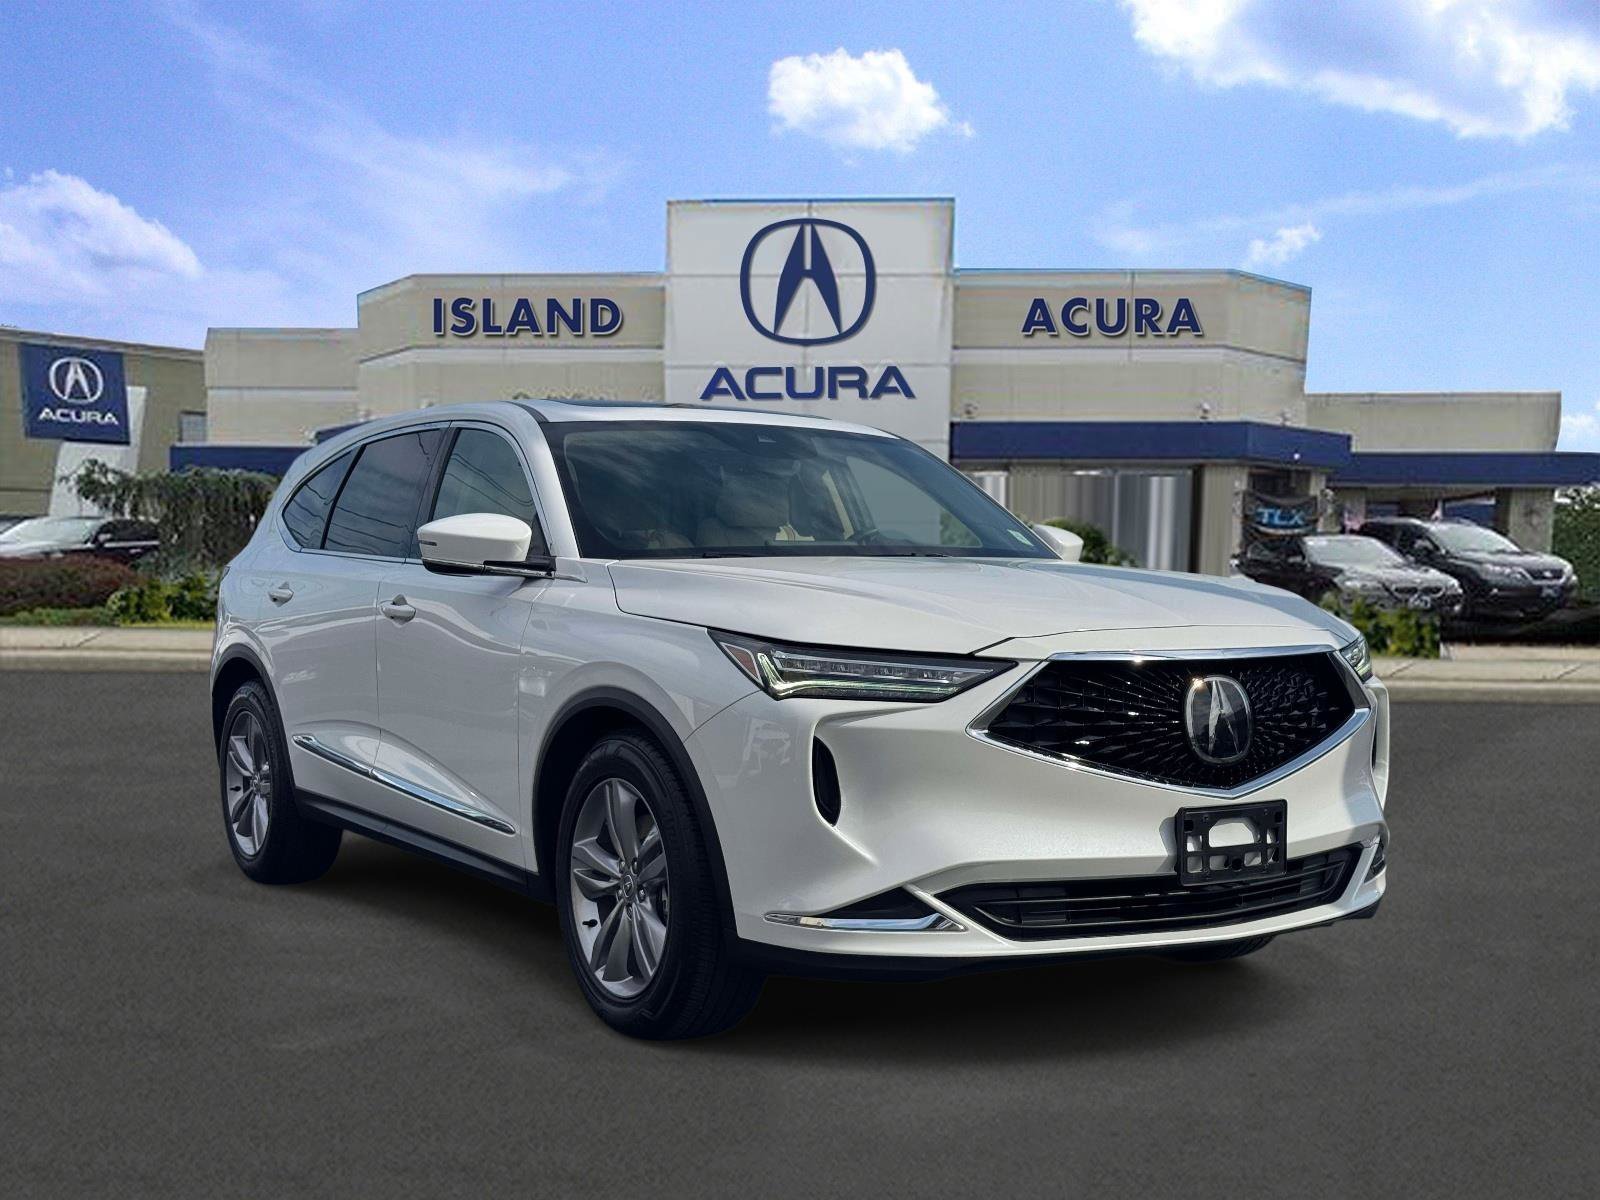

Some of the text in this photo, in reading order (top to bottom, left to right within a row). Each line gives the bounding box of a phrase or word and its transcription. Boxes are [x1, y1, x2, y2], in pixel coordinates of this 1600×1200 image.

[433, 297, 622, 337] ISLAND
[1022, 297, 1203, 337] ACURA
[700, 365, 916, 400] ACURA
[38, 407, 119, 426] ACURA
[1256, 507, 1305, 525] TLX
